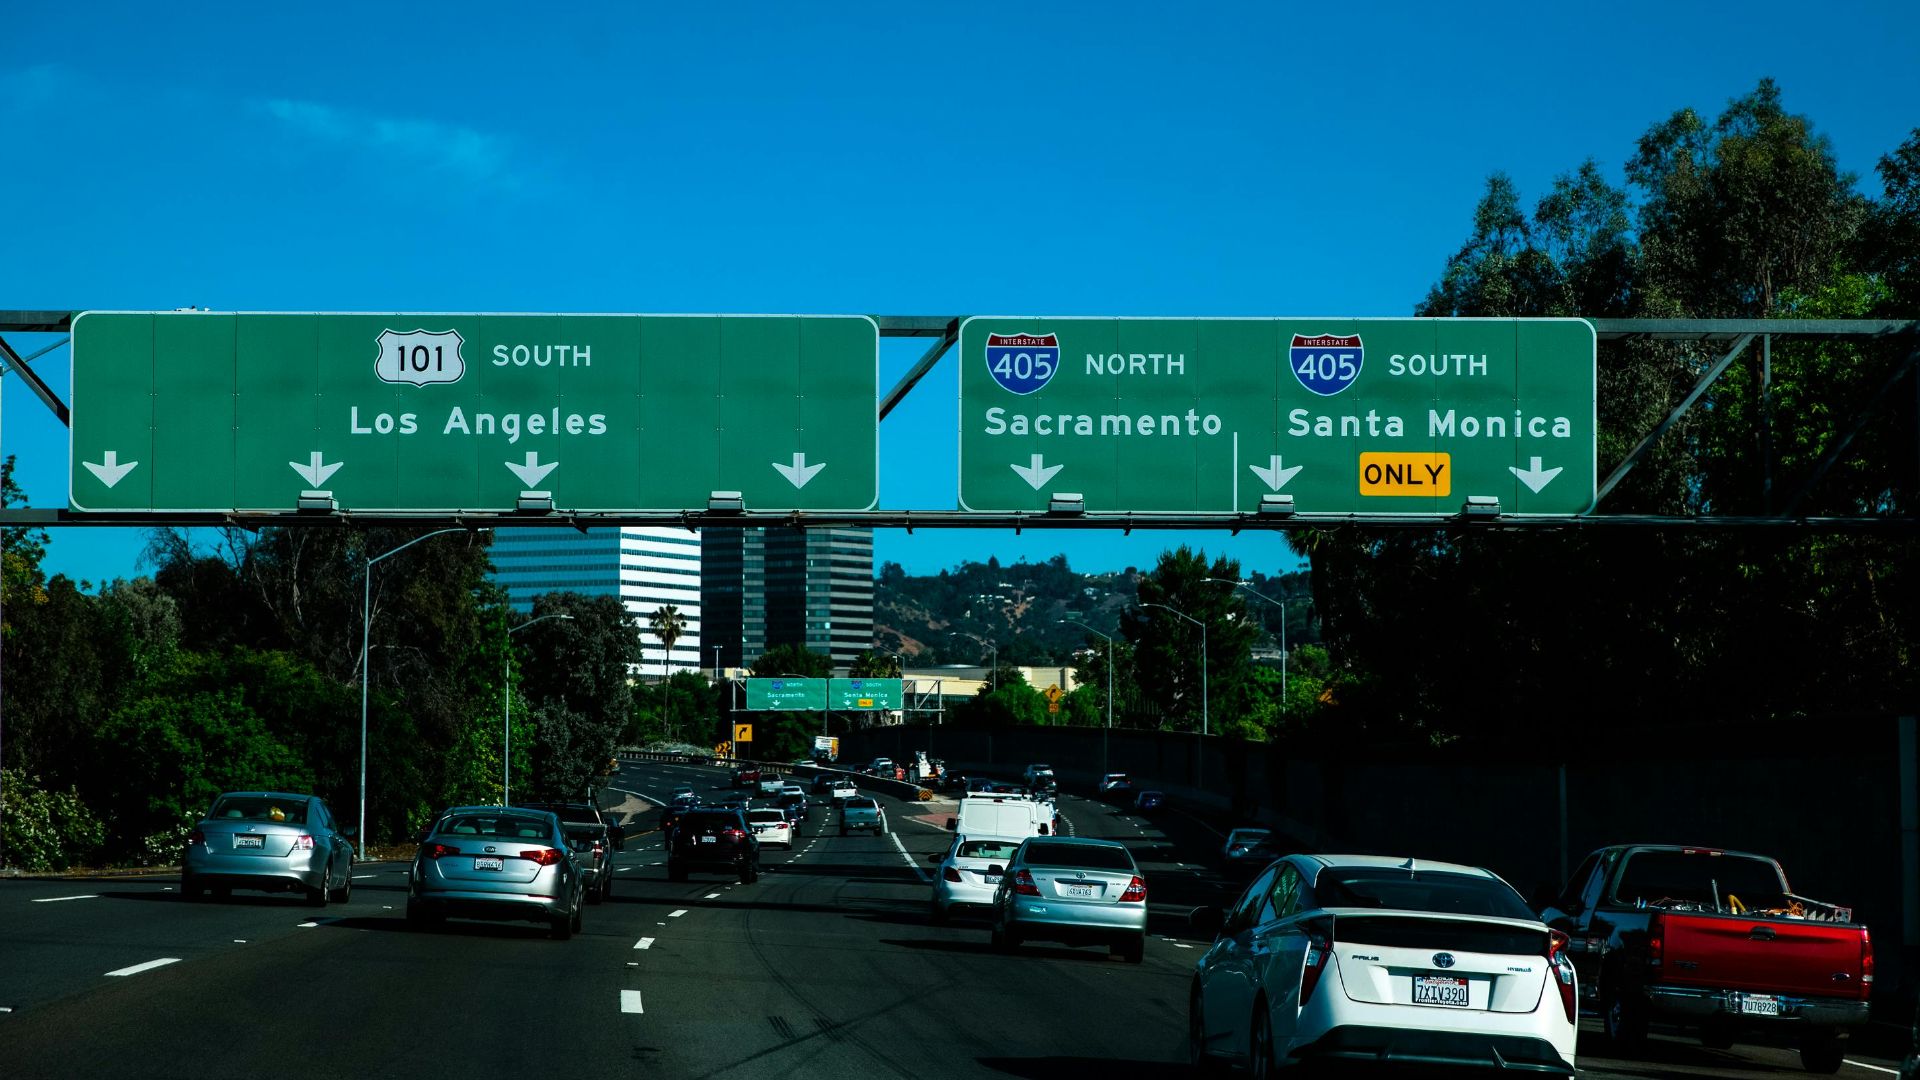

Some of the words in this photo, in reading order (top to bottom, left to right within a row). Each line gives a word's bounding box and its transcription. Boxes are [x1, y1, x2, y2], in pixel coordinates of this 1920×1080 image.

[999, 338, 1046, 346] INTERSTATE
[397, 345, 443, 372] 101
[492, 344, 592, 367] SOUTH
[993, 352, 1053, 380] 405
[1085, 353, 1186, 375] NORTH
[1297, 353, 1357, 381] 405
[1388, 354, 1488, 376] SOUTH
[351, 406, 418, 435] Los
[443, 406, 608, 445] Angeles
[984, 407, 1223, 436] Sacramento
[1287, 408, 1404, 437] Santa
[1428, 408, 1572, 438] Monica
[1364, 463, 1445, 485] ONLY
[1417, 984, 1466, 1002] 7XIV390
